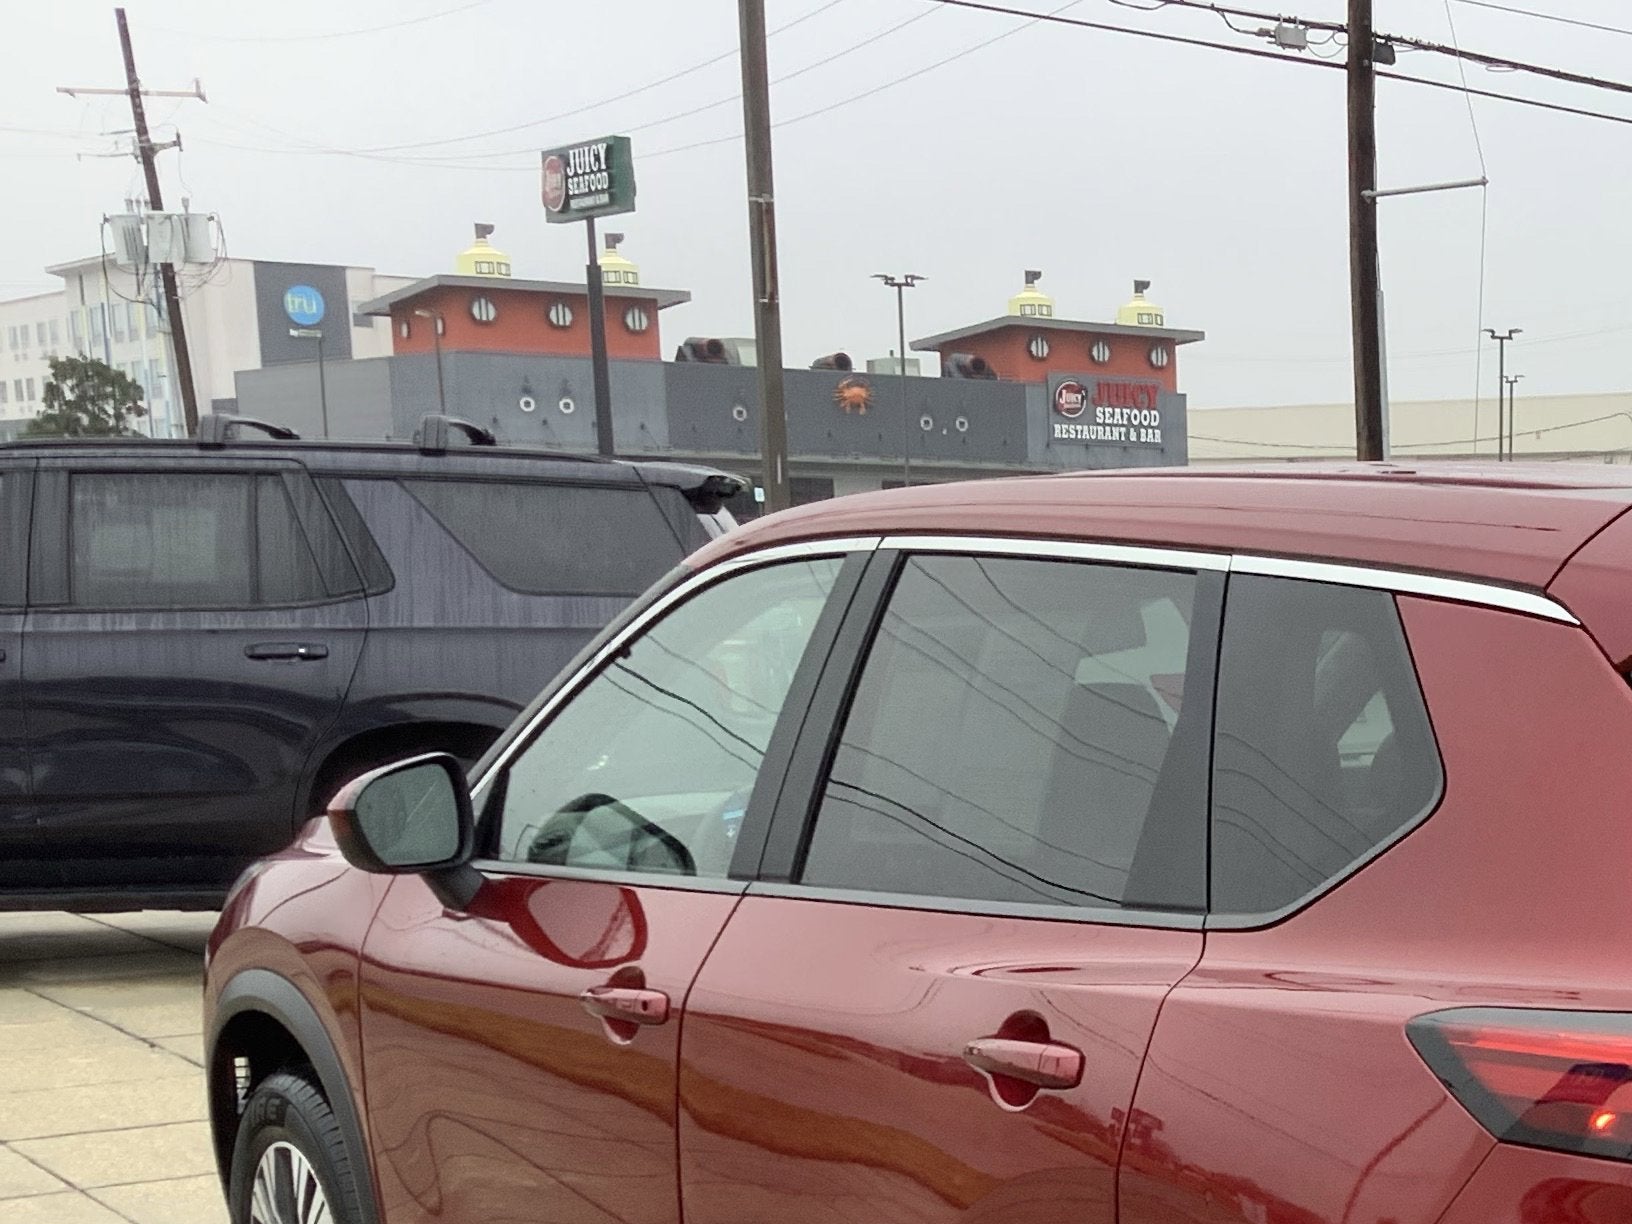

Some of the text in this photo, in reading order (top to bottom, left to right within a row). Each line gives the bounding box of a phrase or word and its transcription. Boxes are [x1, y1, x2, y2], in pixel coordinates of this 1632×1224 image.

[566, 143, 608, 176] JUICY
[568, 172, 609, 195] SEAFOOD
[287, 292, 317, 314] tru
[1092, 381, 1159, 409] JUICY
[1096, 406, 1160, 426] SEAFOOD
[1054, 424, 1162, 443] RESTAURANT & BAR
